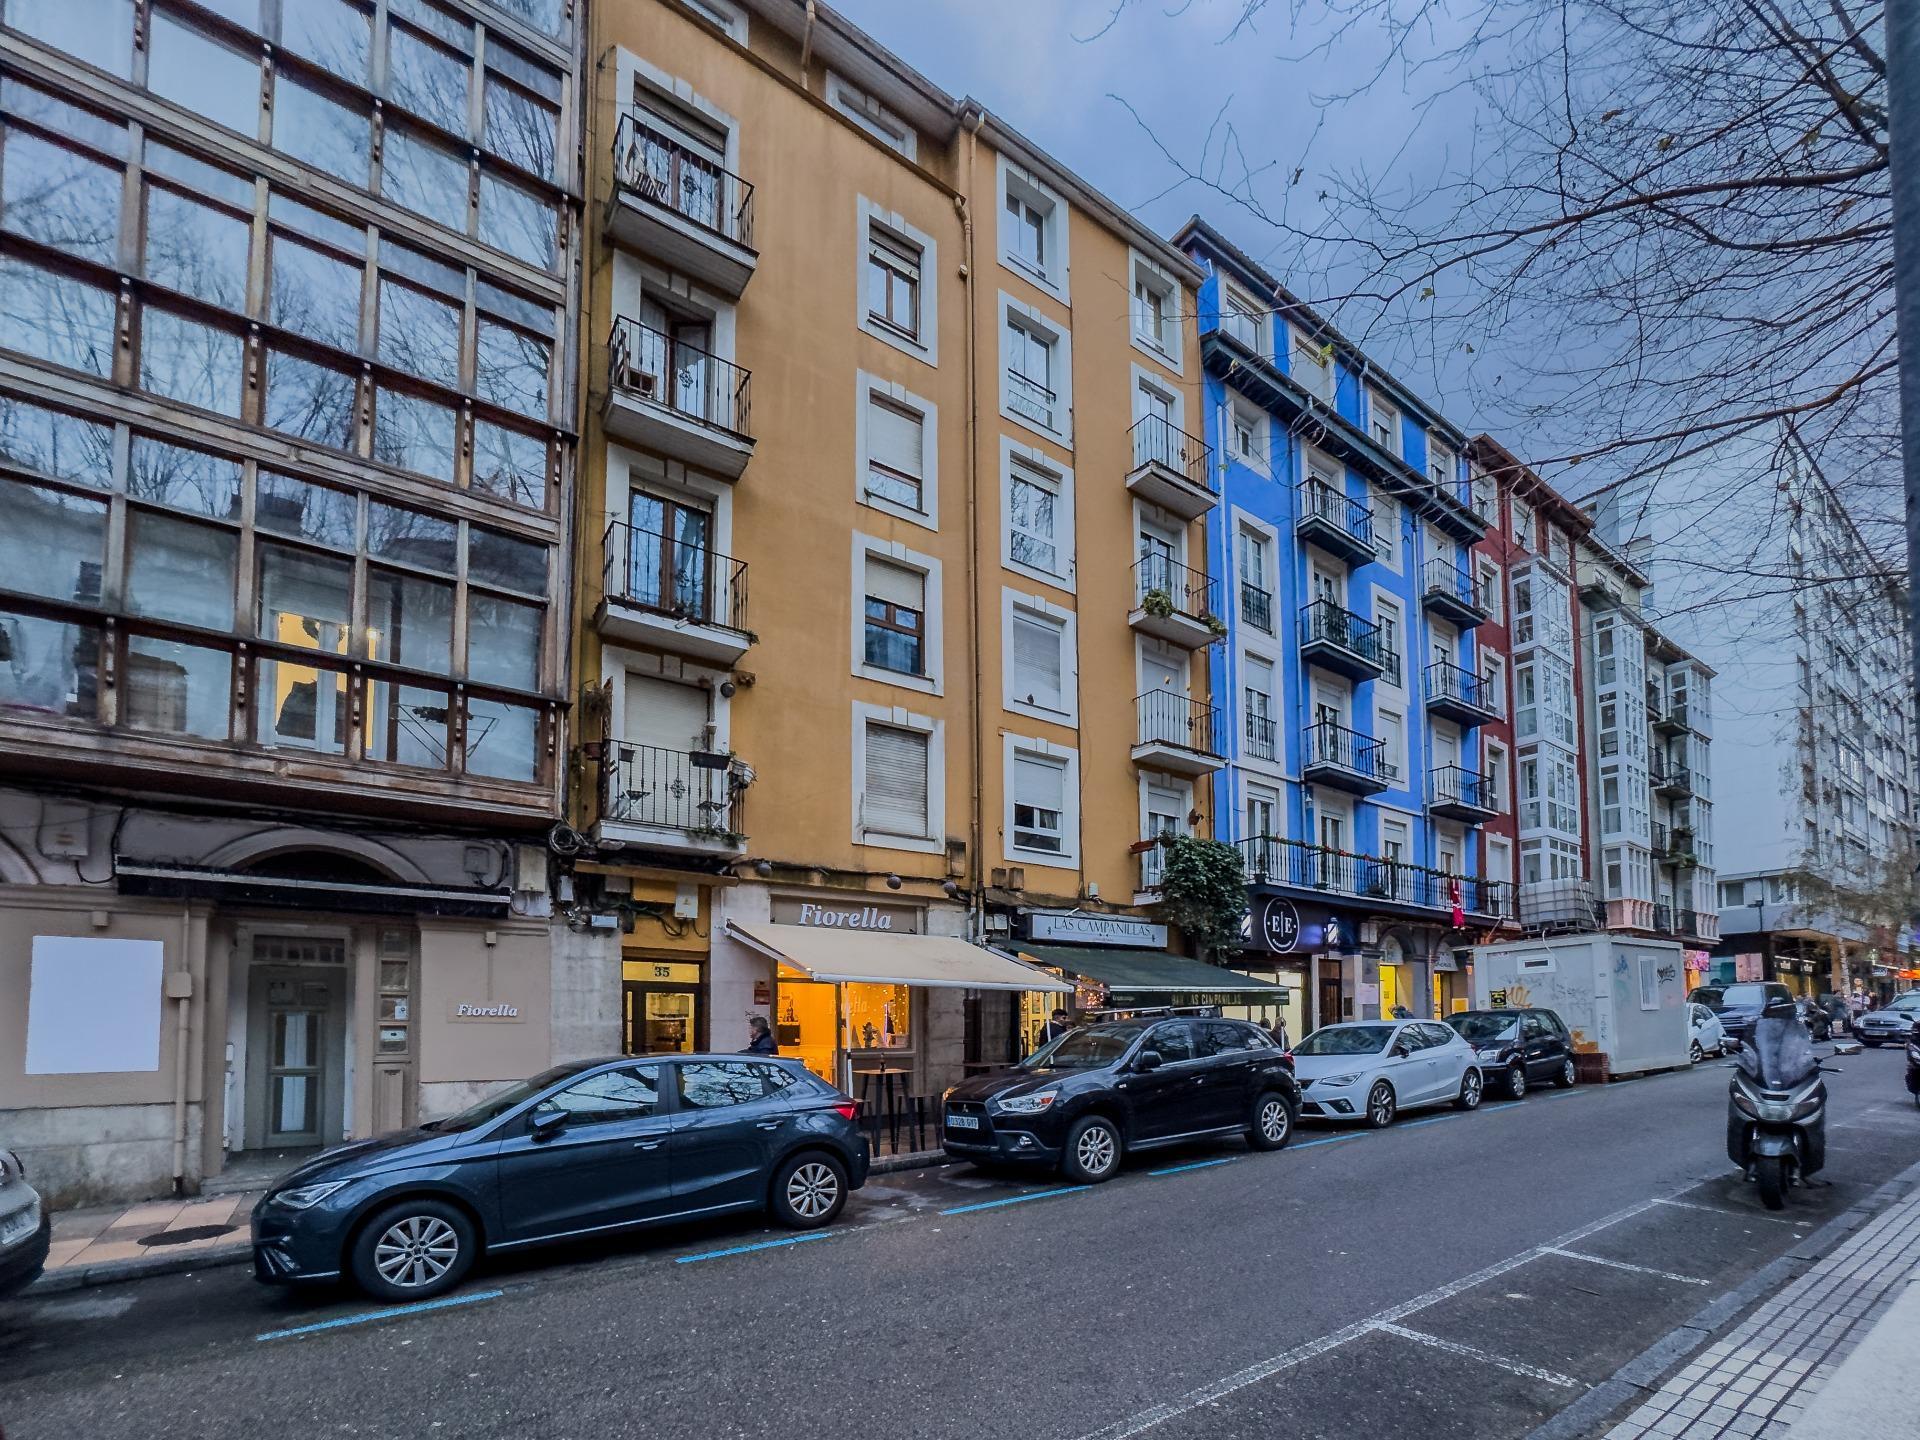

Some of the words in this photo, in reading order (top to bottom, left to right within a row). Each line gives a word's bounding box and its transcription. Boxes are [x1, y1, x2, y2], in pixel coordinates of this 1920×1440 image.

[798, 903, 892, 930] Fiorella
[1054, 916, 1074, 931] LAS
[1077, 919, 1151, 937] CAMPANILLAS
[654, 966, 670, 978] 35
[456, 1004, 518, 1017] Fiorella
